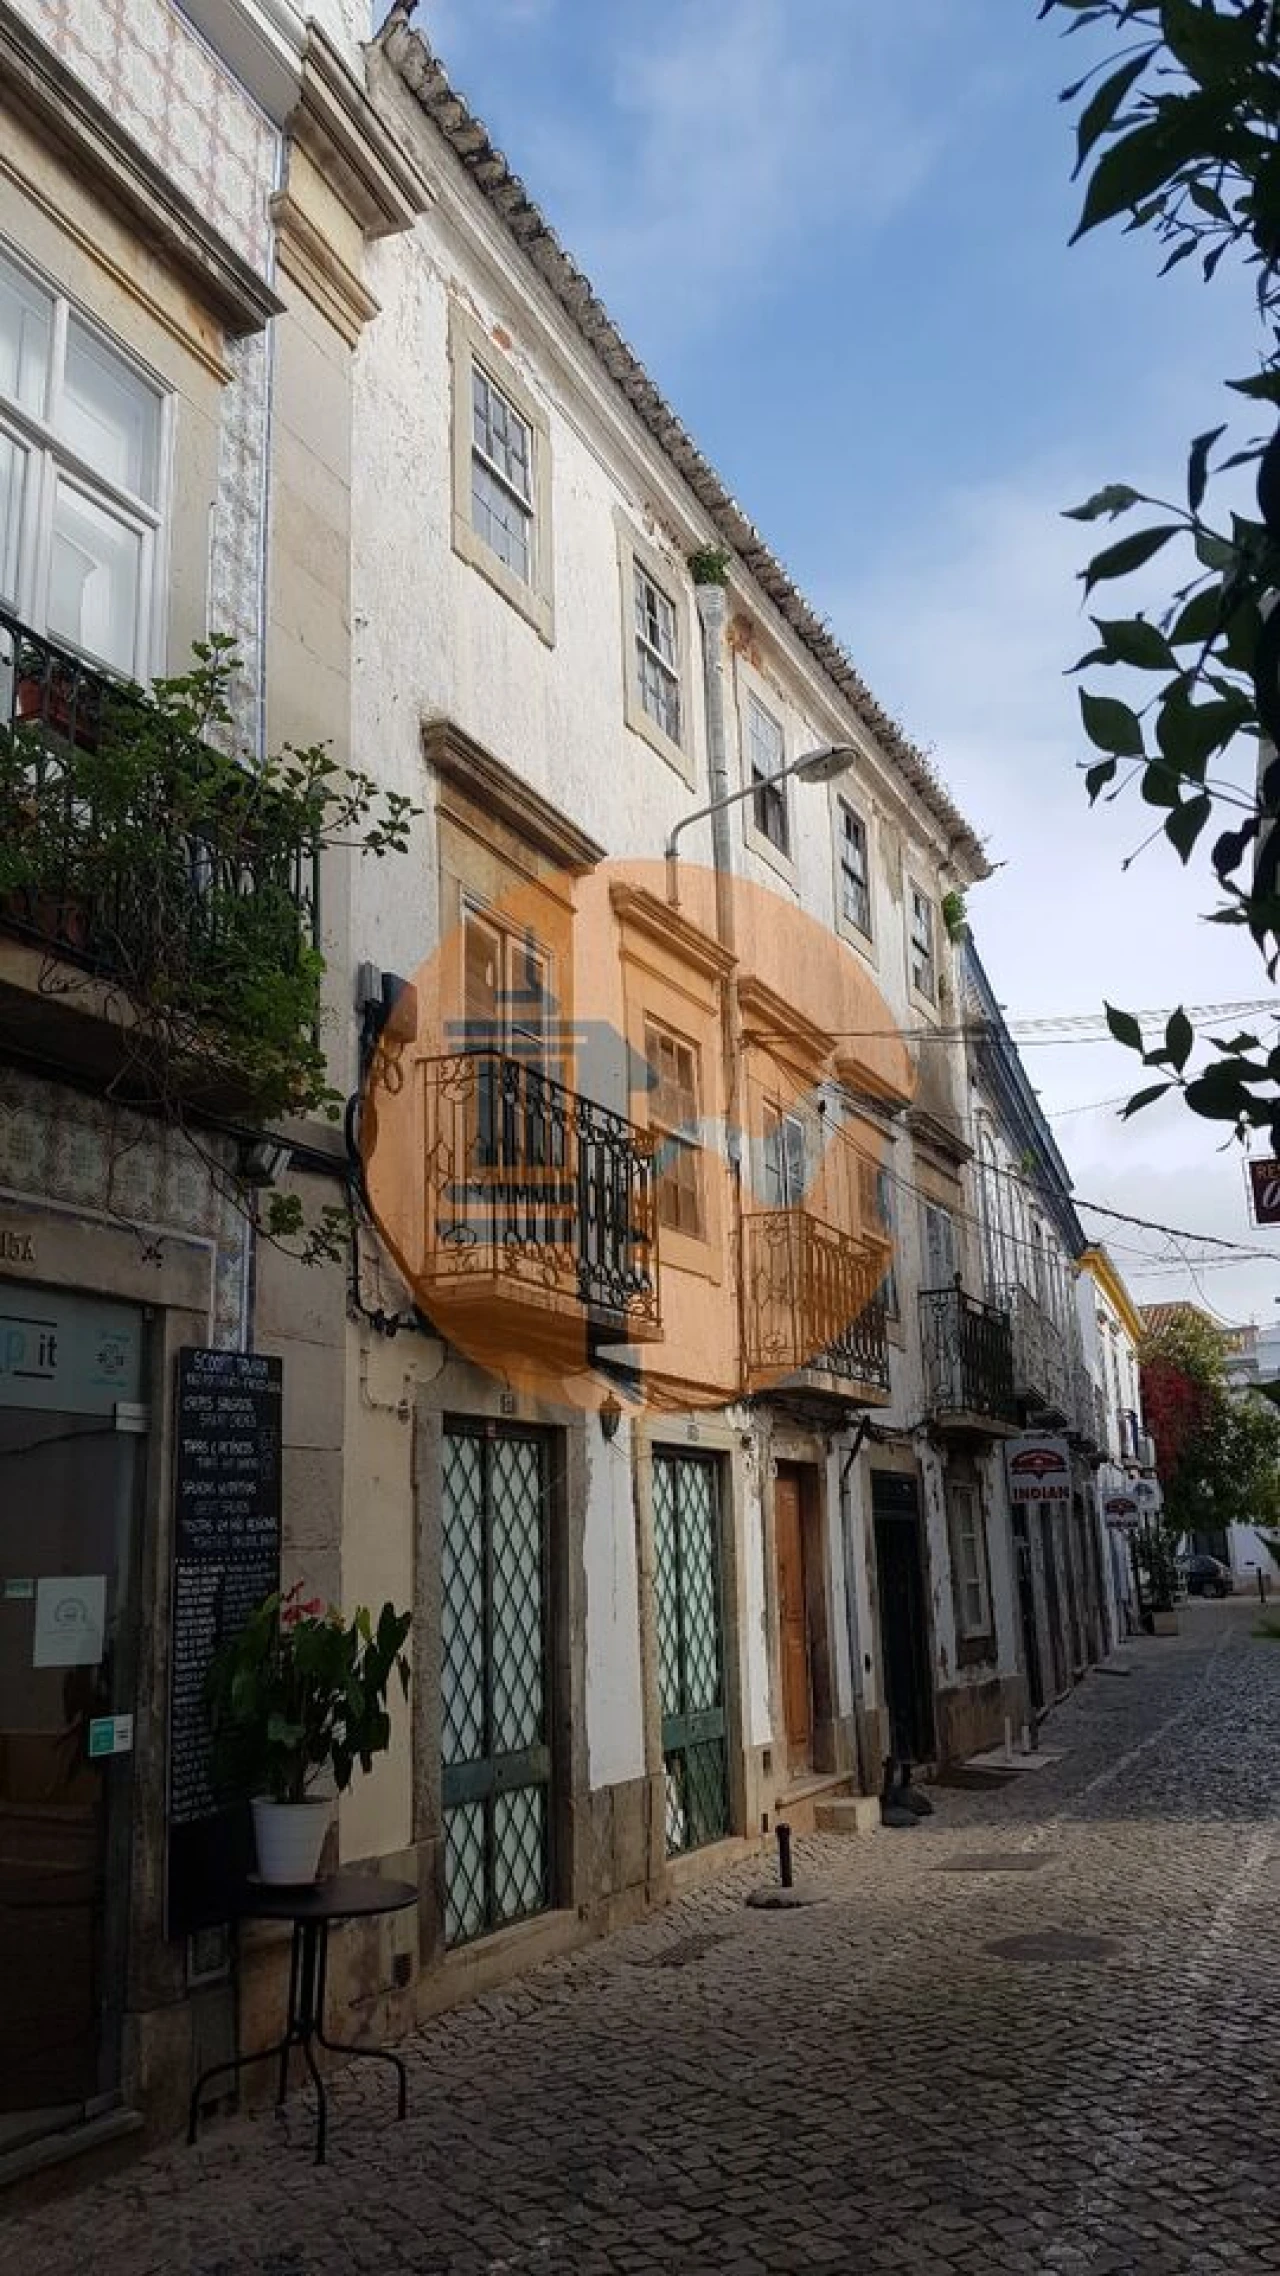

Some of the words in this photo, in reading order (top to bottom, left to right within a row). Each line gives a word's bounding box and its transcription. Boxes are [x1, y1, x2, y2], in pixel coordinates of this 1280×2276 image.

[1255, 1162, 1280, 1181] RE
[38, 1333, 58, 1369] it
[1013, 1485, 1070, 1500] INDIAN
